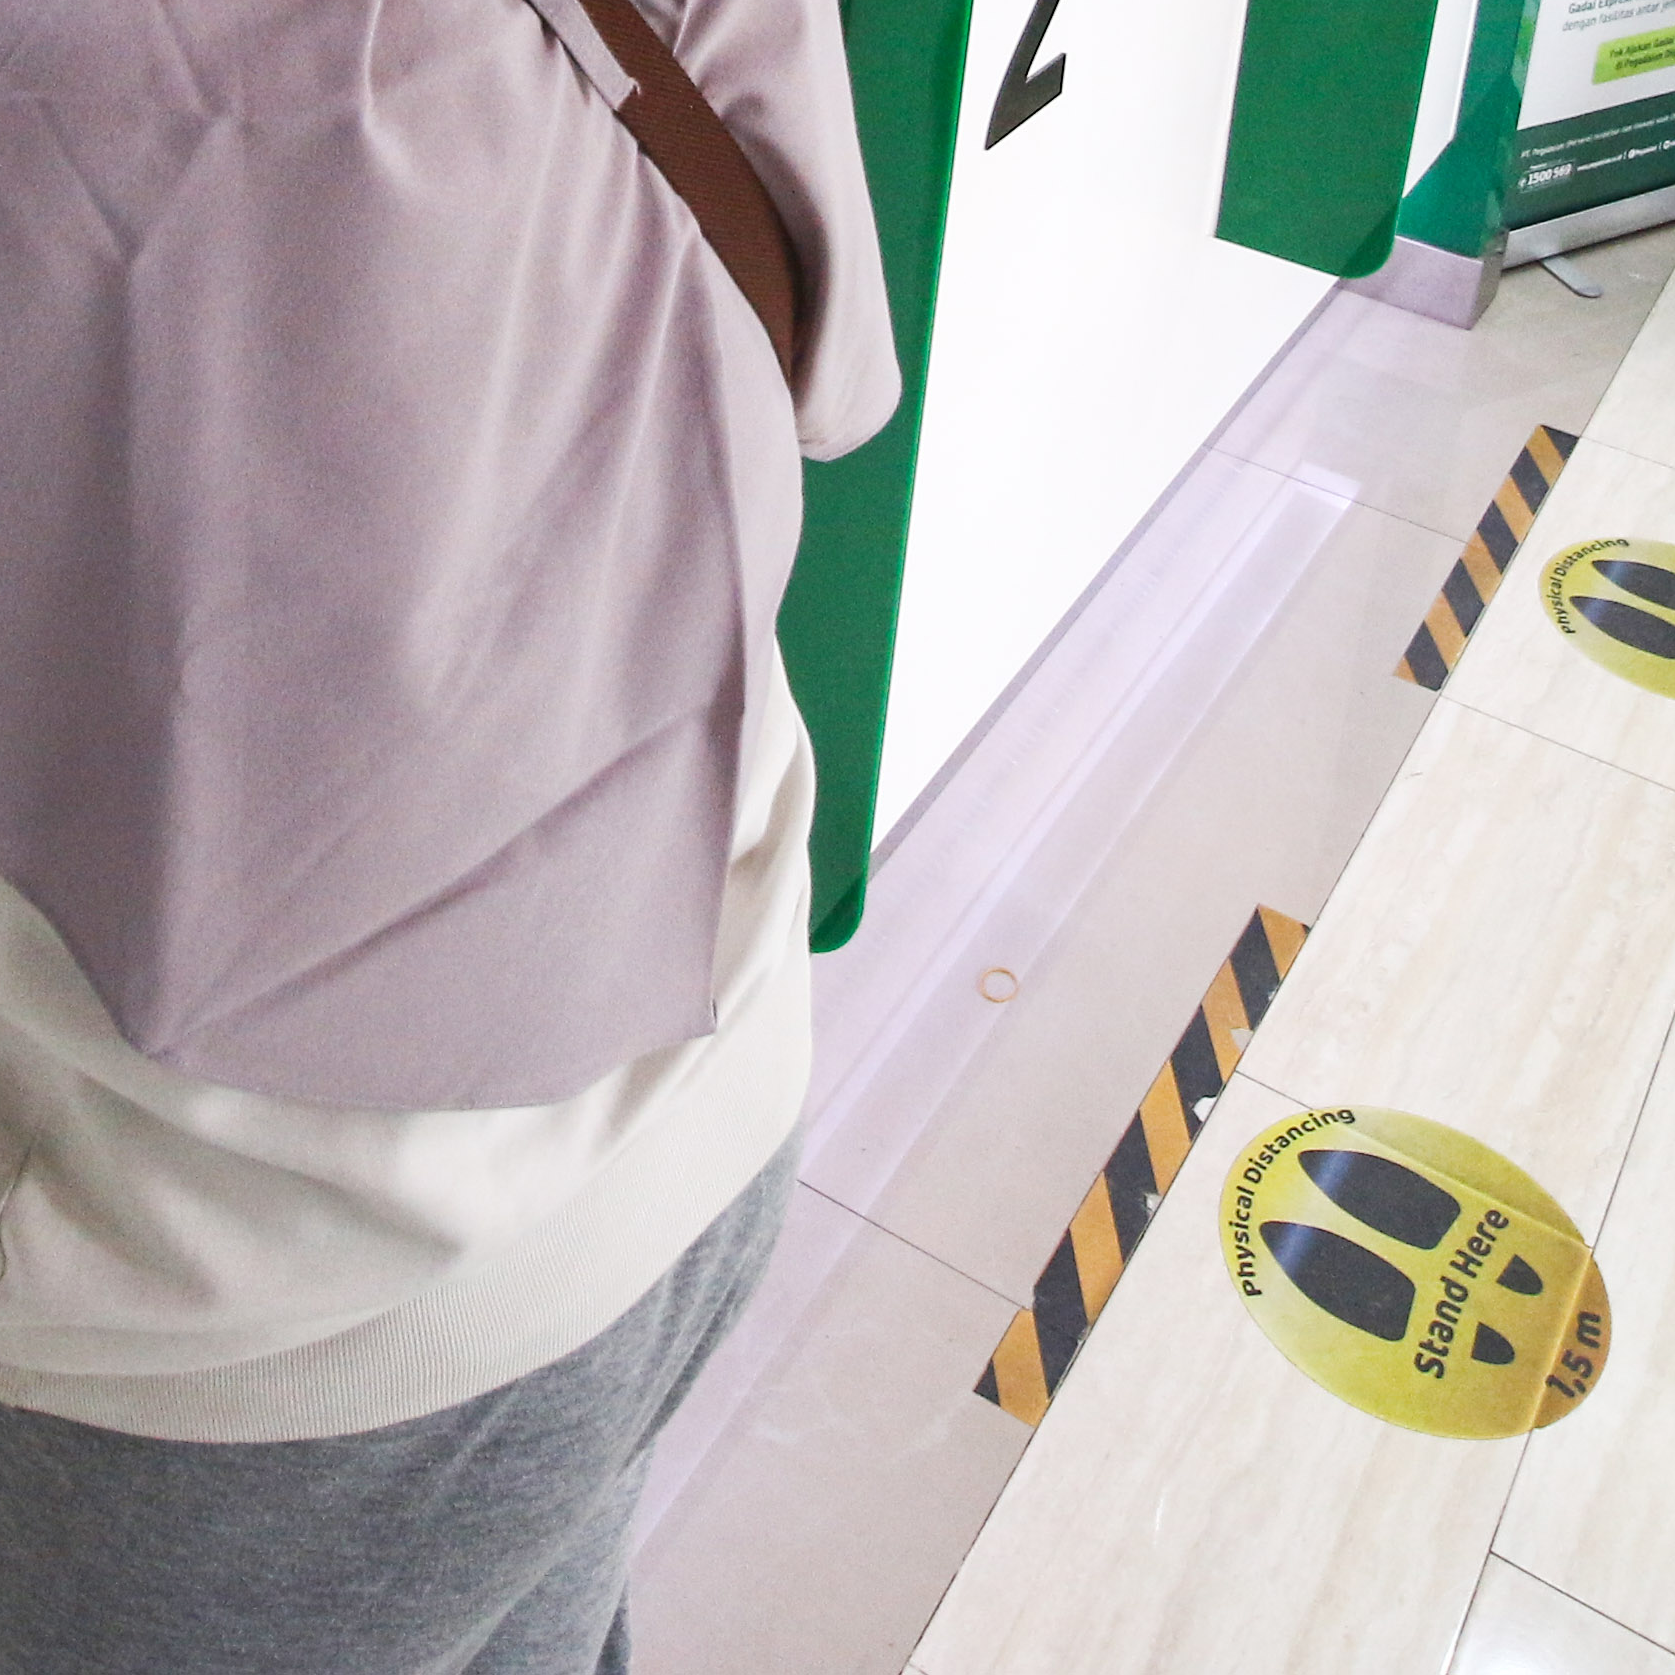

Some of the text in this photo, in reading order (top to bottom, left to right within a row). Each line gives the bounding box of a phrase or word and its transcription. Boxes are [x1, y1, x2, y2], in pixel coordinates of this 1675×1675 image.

[1527, 168, 1552, 187] 1500
[1546, 538, 1629, 634] Physical Distancing
[1229, 1108, 1356, 1297] Physical Distancing
[1414, 1208, 1510, 1380] Stand Here
[1545, 1310, 1602, 1399] 1,5 m
